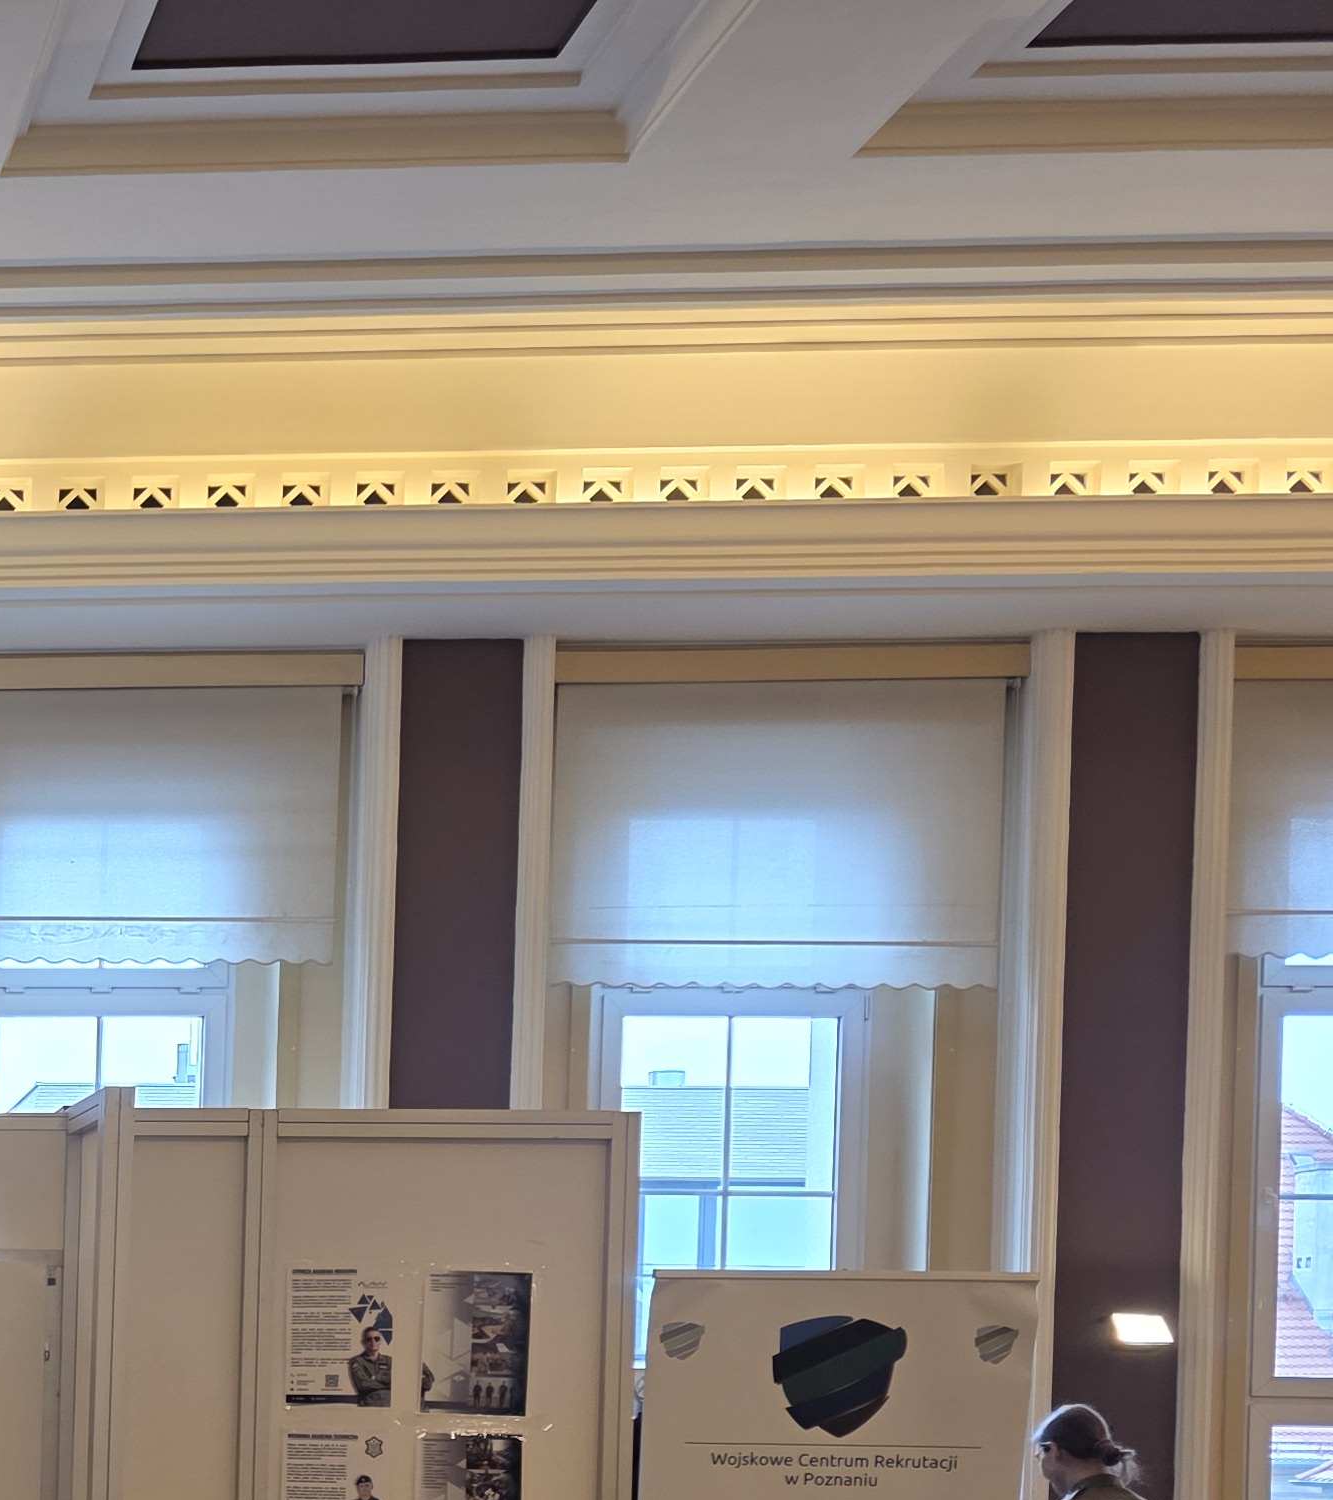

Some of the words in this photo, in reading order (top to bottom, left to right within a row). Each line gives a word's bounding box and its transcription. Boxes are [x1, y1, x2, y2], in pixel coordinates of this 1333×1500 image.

[710, 1452, 794, 1469] Wojskowe
[798, 1453, 869, 1468] Centrum
[874, 1454, 959, 1472] Rekrutacji
[785, 1475, 800, 1486] w
[804, 1472, 879, 1487] Poznaniu
